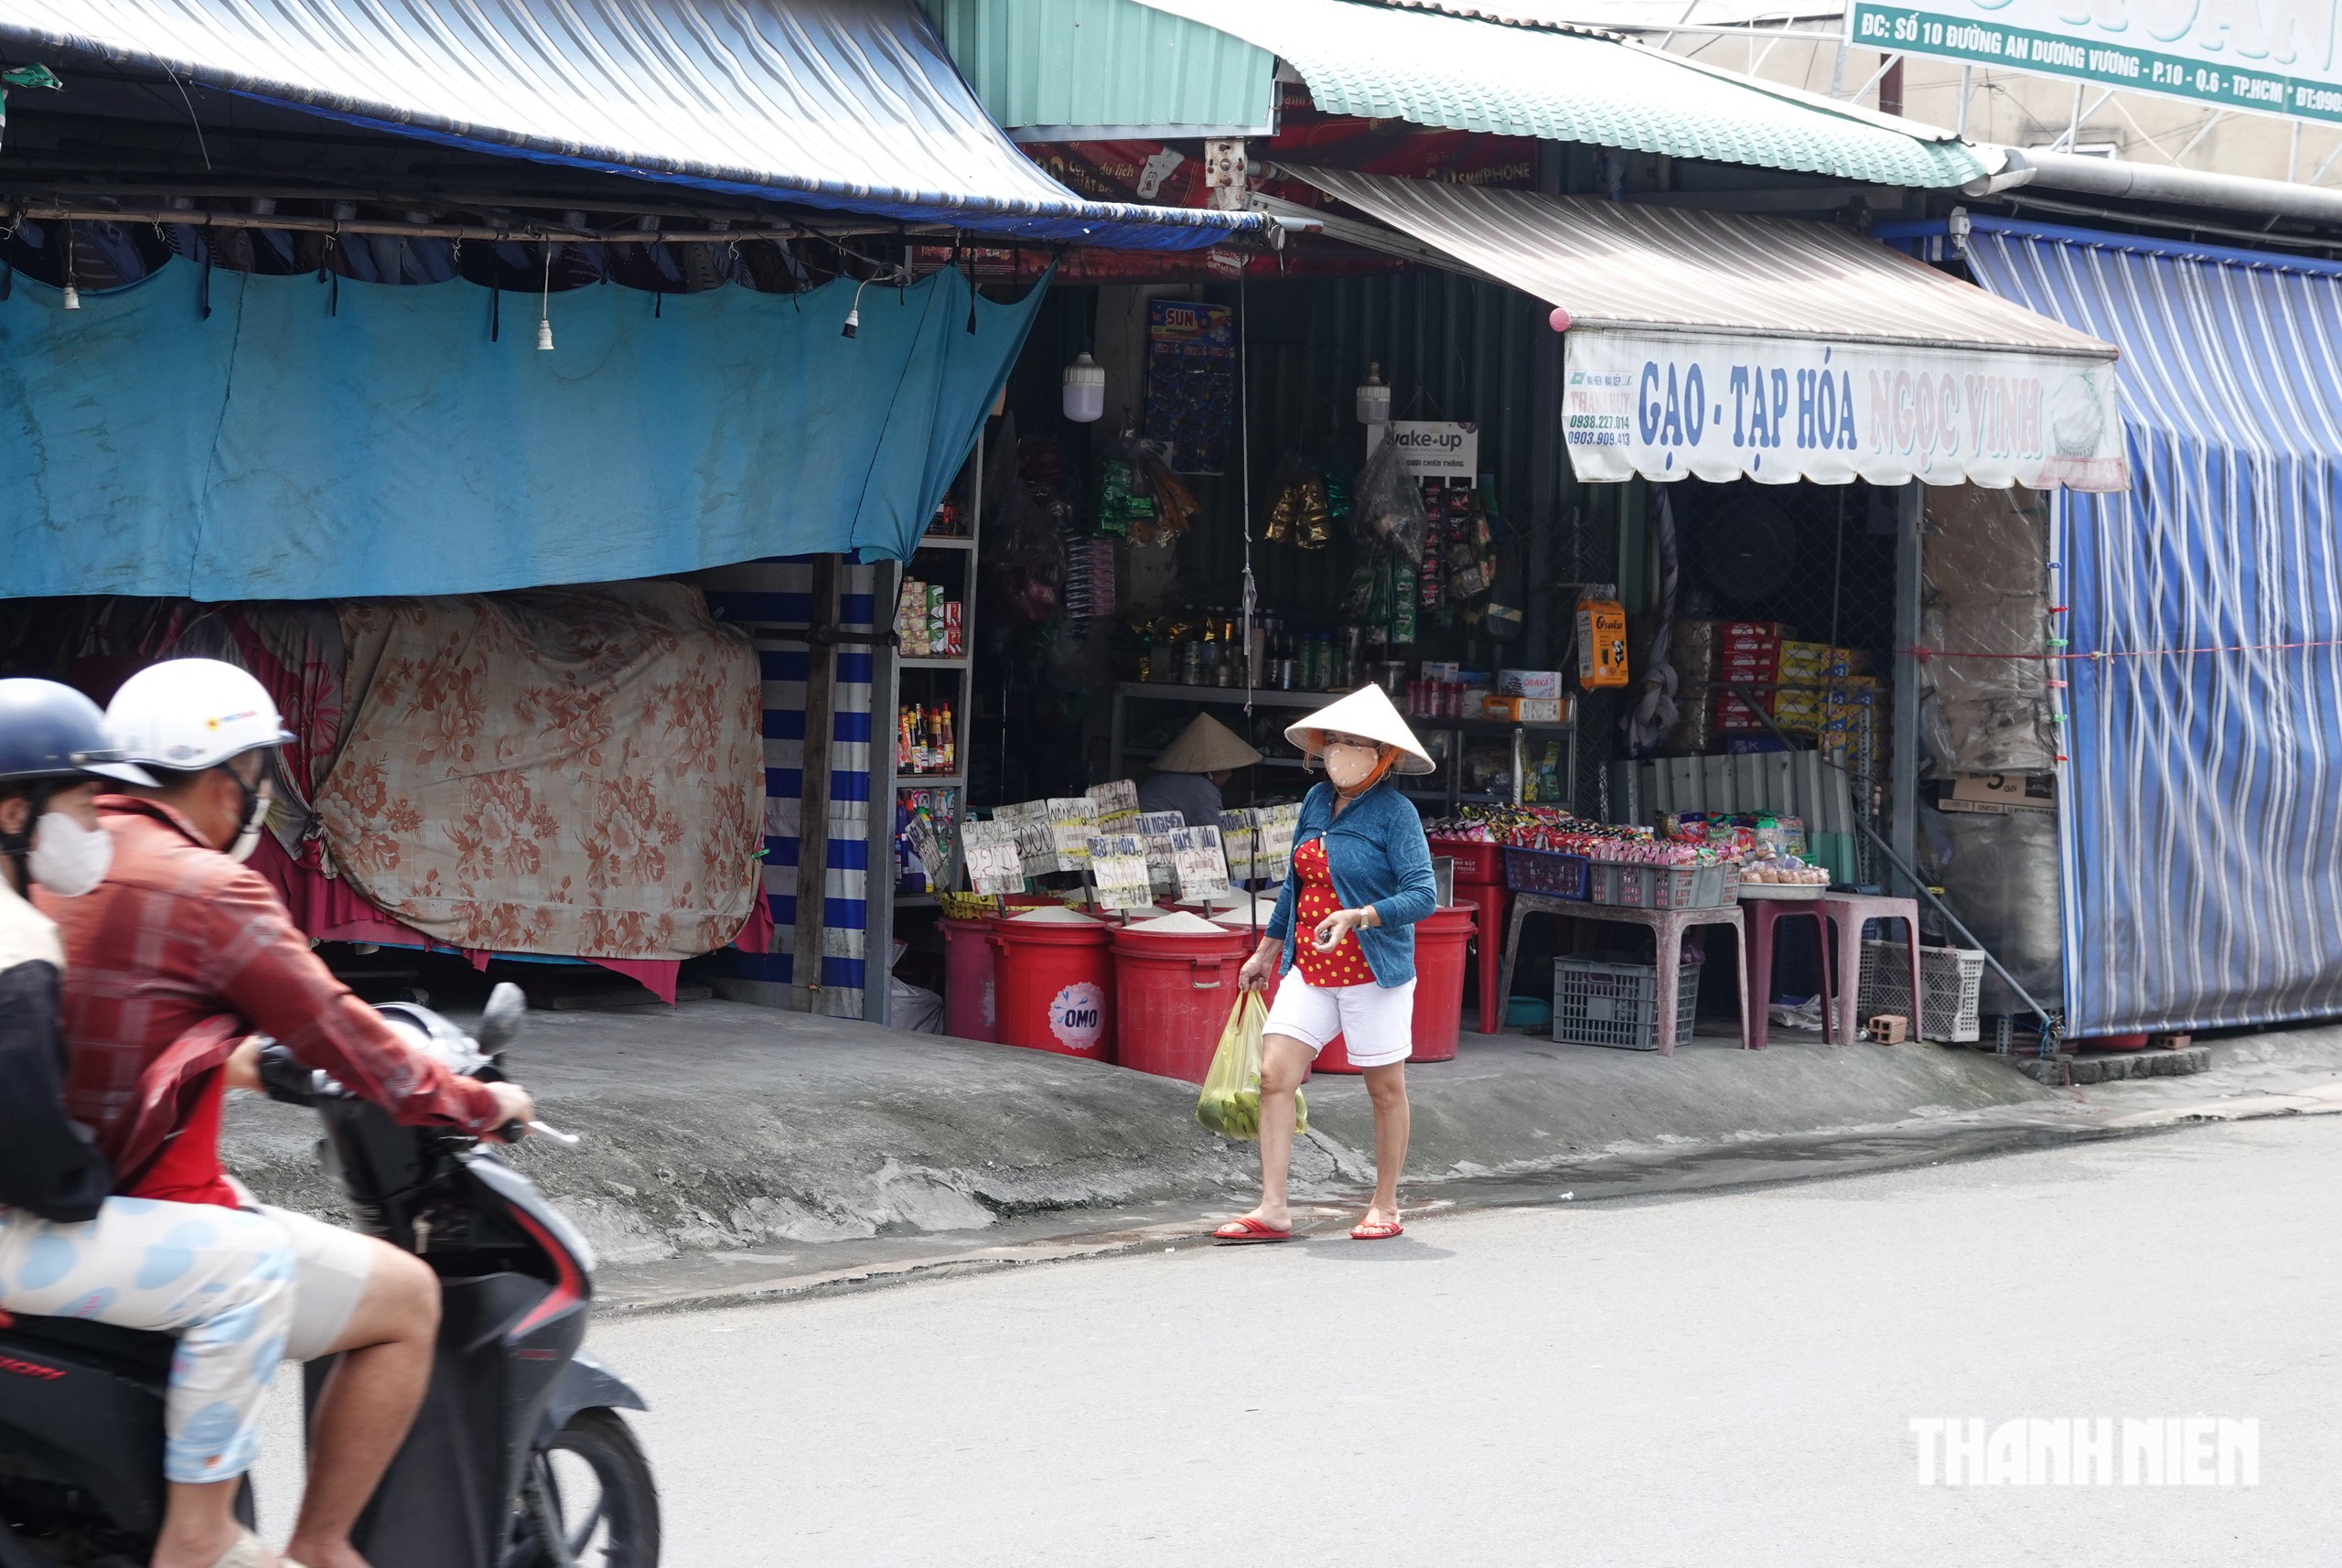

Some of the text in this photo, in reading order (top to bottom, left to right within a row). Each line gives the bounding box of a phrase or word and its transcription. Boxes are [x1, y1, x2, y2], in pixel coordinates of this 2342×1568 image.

[1861, 13, 1890, 38] ĐC:
[1894, 12, 1920, 41] SỐ
[1923, 22, 1943, 46] 10
[1946, 23, 2003, 55] ĐƯỜNG
[2004, 35, 2029, 60] AN
[2032, 39, 2085, 70] DƯƠNG
[2089, 49, 2141, 78] VƯƠNG
[2152, 61, 2184, 86] P.10
[2196, 69, 2219, 93] Q.6
[2232, 75, 2284, 103] TP.HCM
[2295, 87, 2342, 113] ĐT:090
[1166, 307, 1195, 328] SUN
[1638, 360, 1705, 471] GẠO
[1730, 364, 1789, 472] TẠP
[1796, 345, 1858, 451] HÓA
[1868, 368, 1960, 474] NGỌC
[1964, 373, 2043, 460] VINH
[1569, 414, 1629, 430] 0938.227.014
[1568, 431, 1630, 446] 0903.909.413
[1596, 616, 1624, 630] Osaka
[1134, 811, 1184, 834] TÀI NGUYÊN
[1064, 1008, 1098, 1028] OMO
